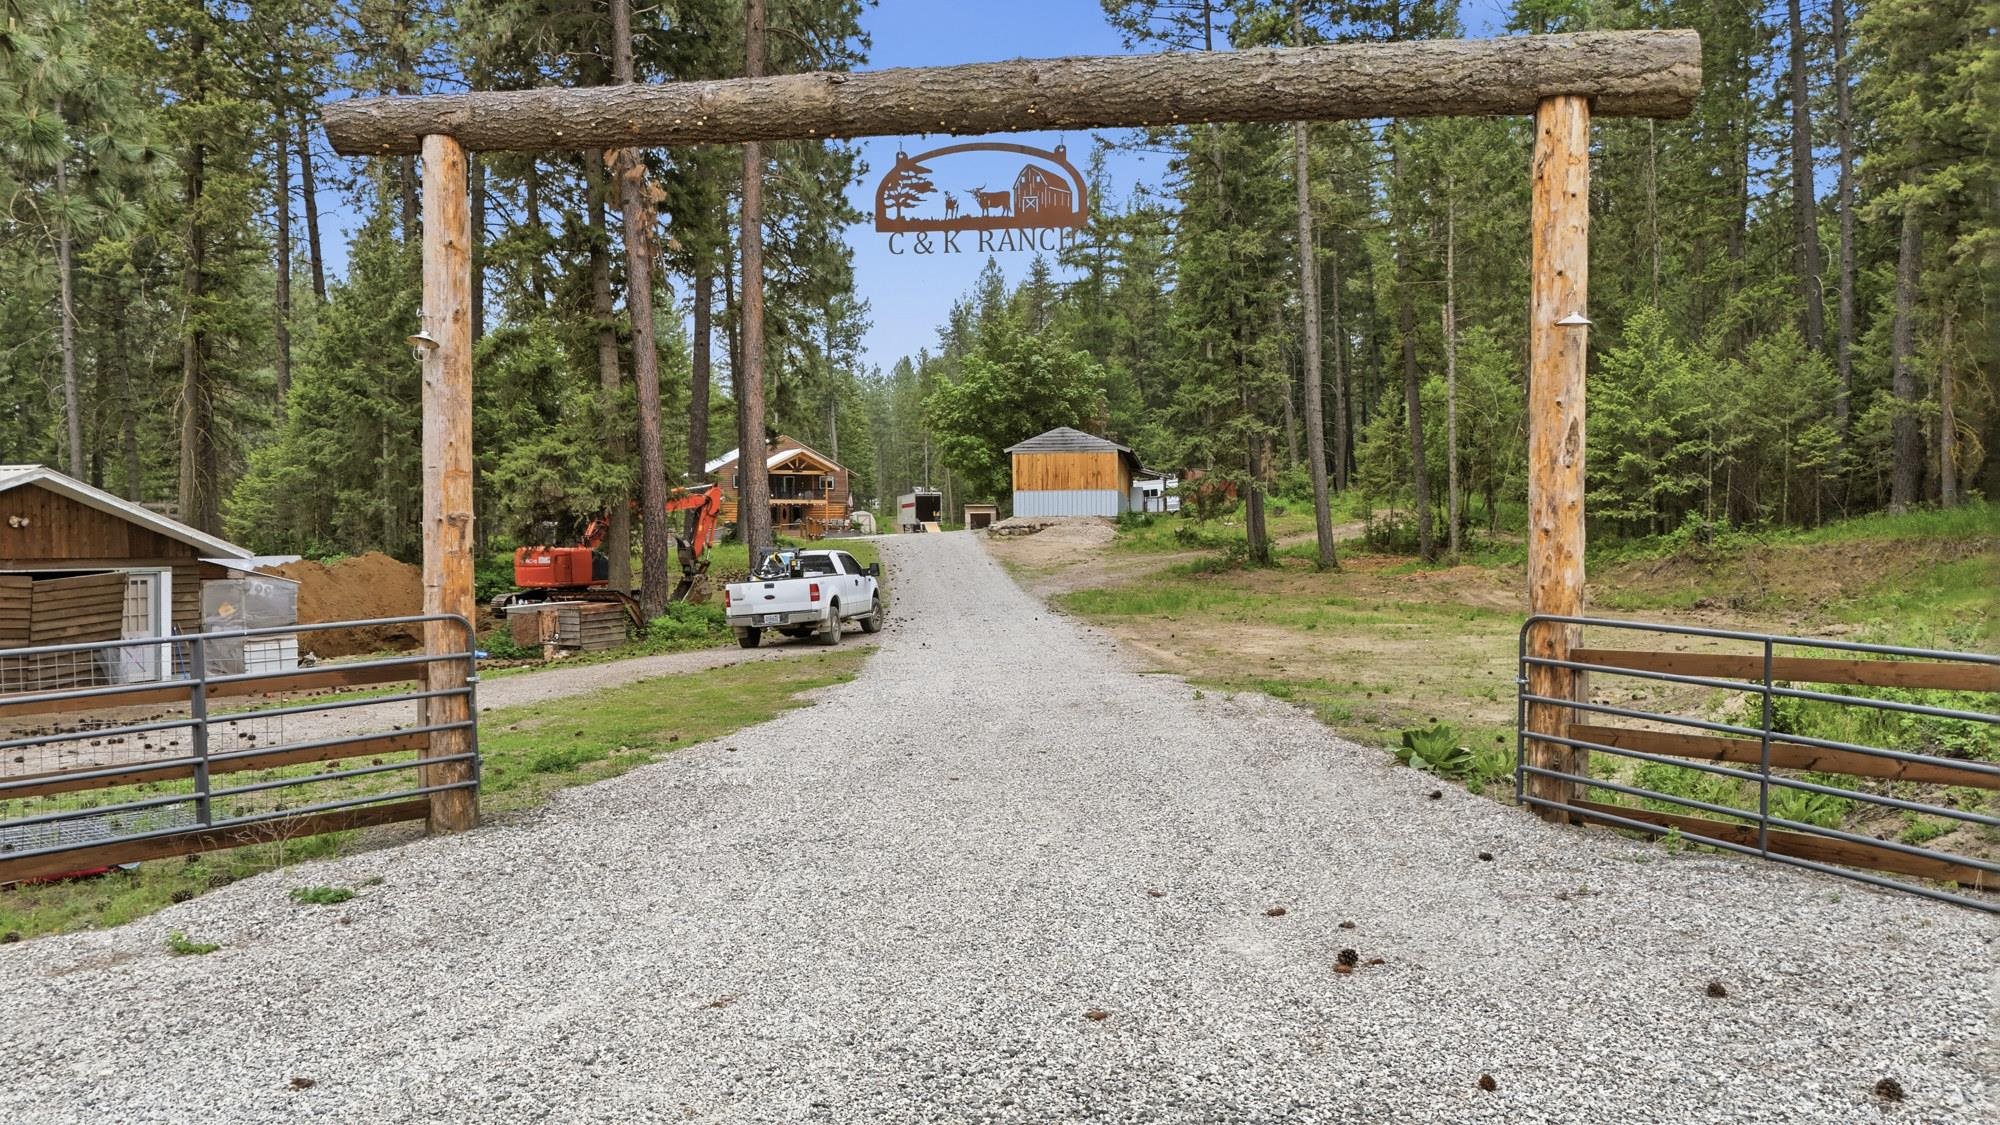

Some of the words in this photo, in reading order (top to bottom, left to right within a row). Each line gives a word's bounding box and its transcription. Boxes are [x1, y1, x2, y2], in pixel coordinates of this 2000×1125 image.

[888, 231, 904, 254] C
[913, 231, 935, 254] &
[943, 229, 961, 253] K
[978, 227, 1076, 252] RANCH
